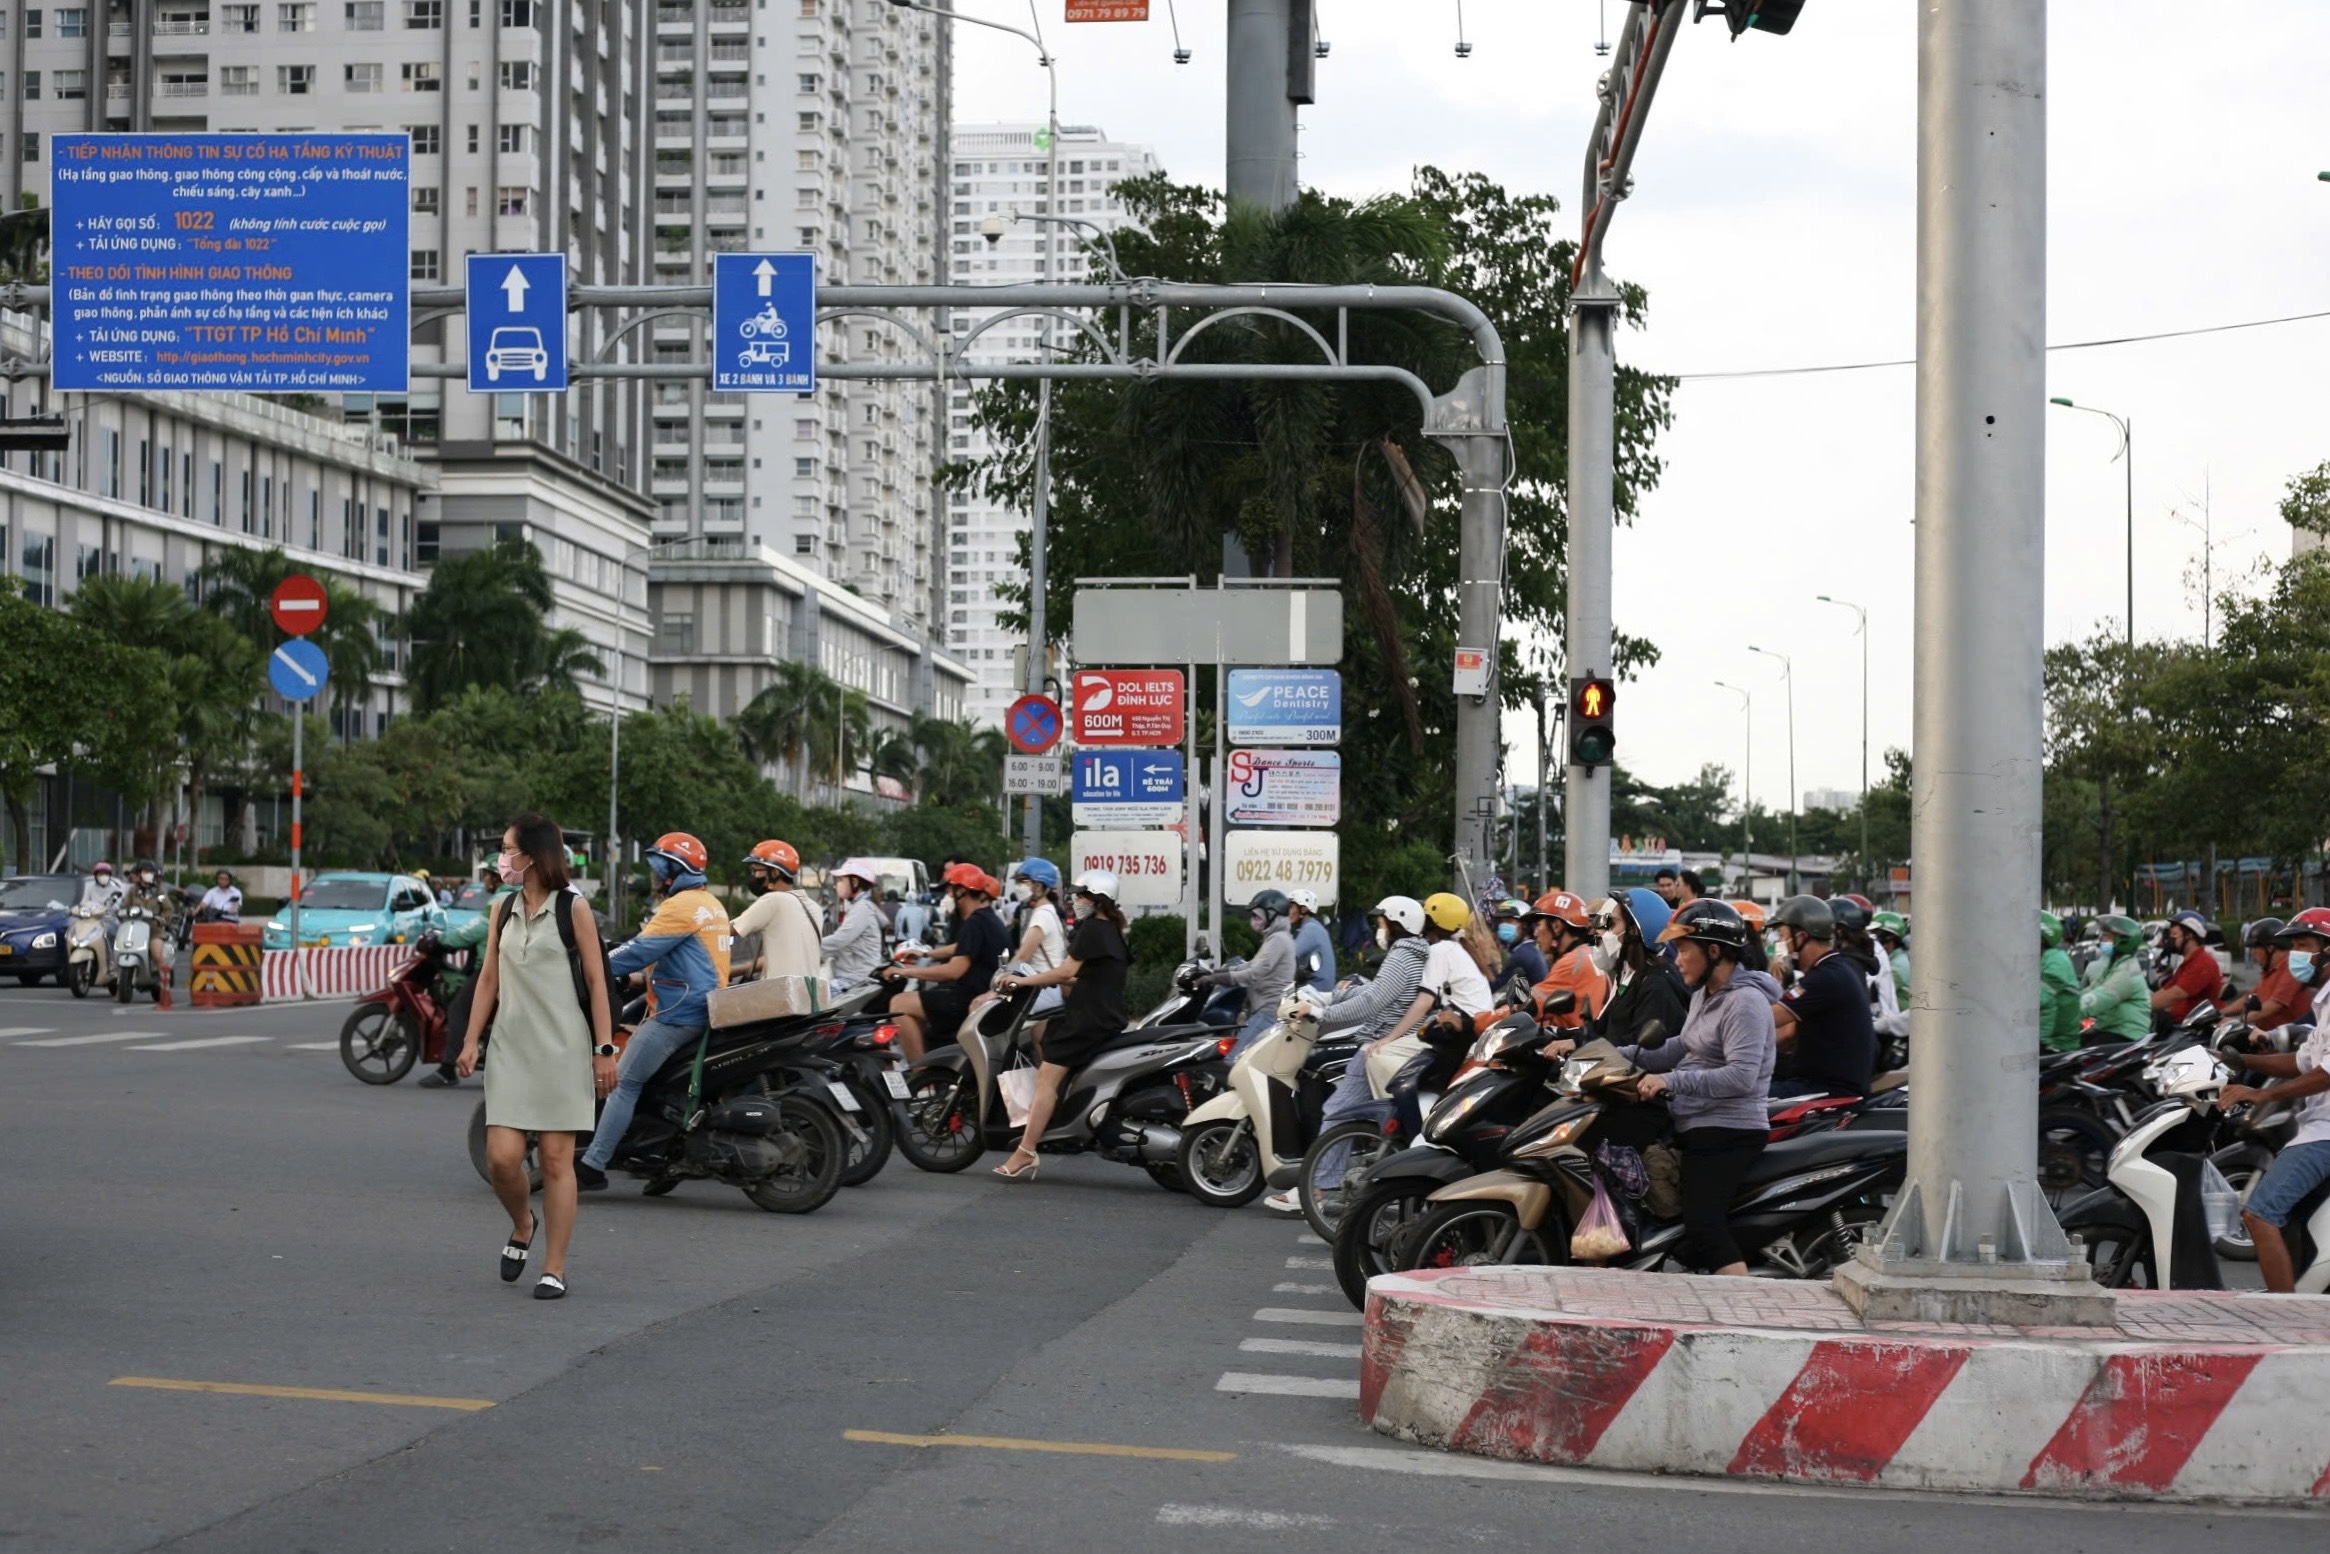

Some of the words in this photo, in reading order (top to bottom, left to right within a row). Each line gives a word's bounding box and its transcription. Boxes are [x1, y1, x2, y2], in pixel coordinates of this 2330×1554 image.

[1067, 9, 1094, 19] 0971
[1097, 8, 1111, 18] 79
[1132, 8, 1146, 17] 79
[67, 142, 97, 159] TIẾP
[101, 144, 142, 162] NHẬN
[146, 144, 193, 159] THÔNG
[198, 145, 219, 159] TIN
[224, 145, 243, 161] SỰ
[246, 140, 266, 159] CỐ
[269, 146, 289, 161] HẠ
[357, 143, 403, 162] THUẬT
[59, 168, 79, 182] (Hạ
[109, 172, 133, 183] giao
[175, 172, 199, 183] giao
[202, 168, 234, 183] thông
[238, 169, 265, 183] công
[303, 166, 322, 182] cấp
[326, 168, 338, 180] và
[342, 168, 371, 180] thoát
[173, 184, 204, 197] chiếu
[241, 186, 260, 200] cây
[116, 218, 136, 232] GỌI
[174, 212, 214, 230] 1022
[230, 218, 270, 233] (không
[273, 218, 297, 230] tính
[300, 218, 330, 230] cước
[332, 219, 360, 233] cuộc
[363, 219, 387, 233] gọi)
[89, 234, 107, 250] TẢI
[111, 234, 138, 250] ỨNG
[68, 266, 104, 280] THEO
[134, 264, 166, 280] TÌNH
[170, 264, 204, 280] HÌNH
[208, 266, 240, 280] GIAO
[244, 263, 292, 280] THÔNG
[69, 288, 95, 301] (Bản
[116, 289, 137, 300] tình
[141, 290, 170, 303] trạng
[174, 292, 198, 303] giao
[201, 289, 233, 303] thông
[236, 289, 261, 300] theo
[265, 288, 287, 300] thời
[290, 292, 314, 303] gian
[349, 291, 393, 301] camera
[74, 309, 98, 321] giao
[140, 305, 167, 321] phản
[171, 307, 191, 319] ánh
[195, 309, 210, 321] sự
[213, 304, 227, 319] cố
[229, 307, 243, 321] hạ
[274, 306, 285, 319] và
[289, 308, 309, 319] các
[312, 307, 333, 321] tiện
[337, 307, 354, 319] ích
[357, 307, 388, 320] khác)
[90, 327, 108, 342] TẢI
[111, 327, 138, 342] ỨNG
[240, 326, 261, 342] TP
[267, 324, 289, 343] Hồ
[295, 326, 321, 343] Chí
[147, 369, 162, 383] SỞ
[164, 373, 189, 383] GIAO
[191, 370, 227, 384] THÔNG
[230, 370, 252, 386] VẬN
[255, 370, 272, 384] TẢI
[309, 371, 326, 384] CHÍ
[720, 373, 730, 385] XE
[732, 374, 738, 385] 2
[778, 374, 784, 385] 3
[1118, 682, 1143, 692] DOL
[1145, 682, 1175, 692] IELTS
[1274, 686, 1329, 699] PEACE
[1118, 693, 1146, 705] ĐÌNH
[1150, 695, 1173, 707] LỰC
[1274, 700, 1329, 709] Dentistry
[1085, 715, 1122, 728] 600M
[1306, 730, 1336, 741] 300M
[1253, 757, 1281, 766] Dance
[1286, 758, 1315, 767] Sports
[1085, 757, 1120, 787] ila
[1155, 777, 1173, 785] TRÁI
[1244, 847, 1259, 856] LIÊN
[1084, 856, 1114, 872] 0919
[1118, 856, 1140, 875] 735
[1145, 856, 1166, 875] 736
[1237, 860, 1271, 881] 0922
[1276, 860, 1292, 881] 48
[1298, 860, 1332, 883] 7979
